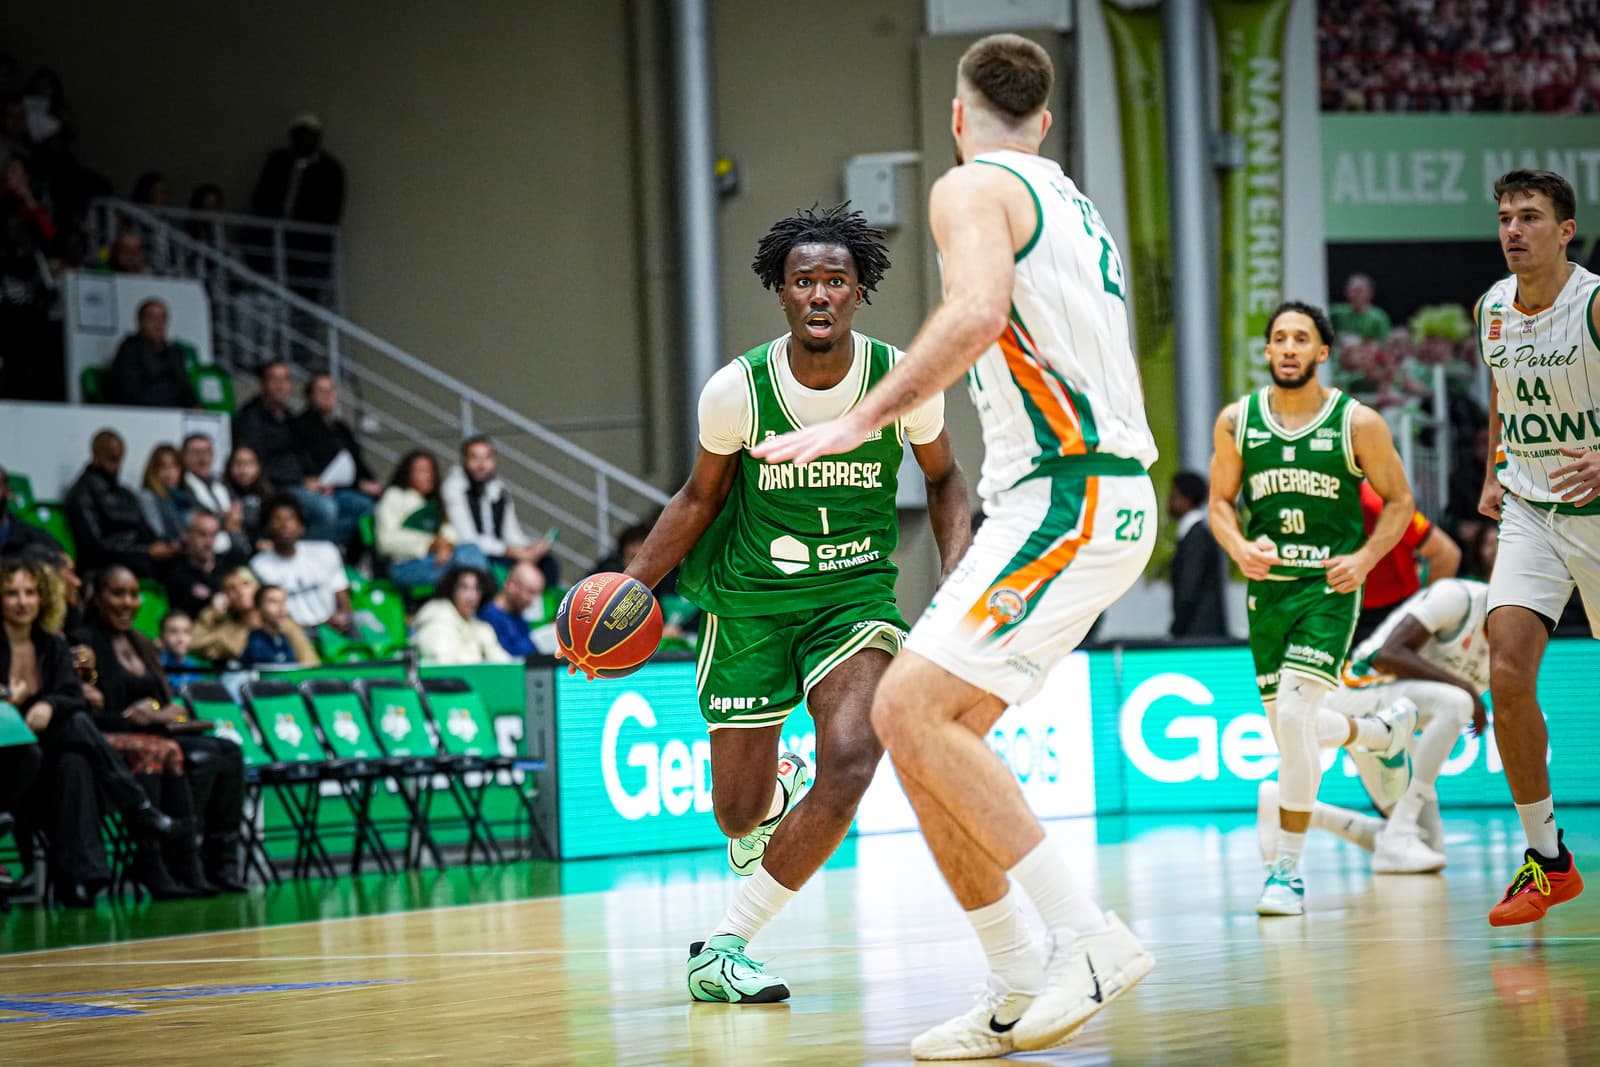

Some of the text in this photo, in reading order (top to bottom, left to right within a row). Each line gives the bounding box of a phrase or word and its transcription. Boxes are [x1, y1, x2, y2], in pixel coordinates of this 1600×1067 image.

[1249, 58, 1280, 314] NANTERRE
[1332, 152, 1465, 202] ALLEZ
[1489, 344, 1578, 368] Le Portel
[1517, 376, 1552, 406] 44
[758, 461, 882, 491] NANTERRE92
[817, 507, 829, 535] 1
[1115, 509, 1145, 541] 23
[1279, 508, 1305, 534] 30
[816, 536, 871, 559] GTM
[1281, 544, 1330, 559] GTM
[709, 694, 756, 713] Sepur
